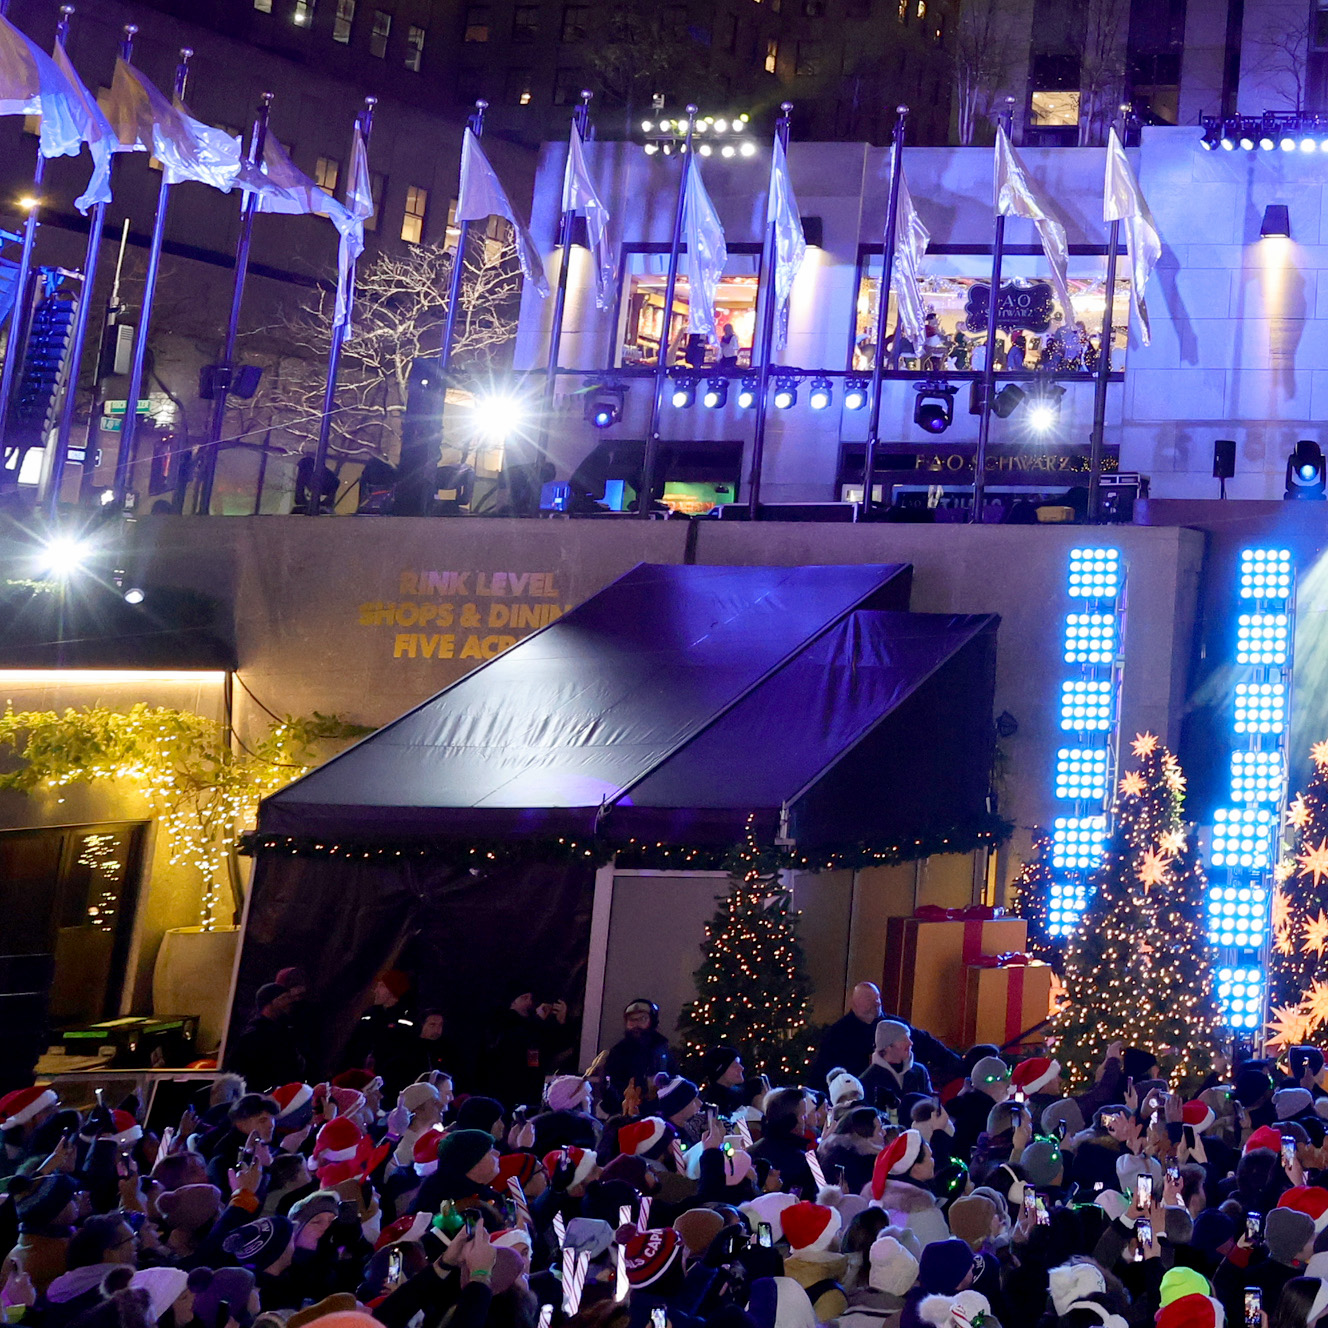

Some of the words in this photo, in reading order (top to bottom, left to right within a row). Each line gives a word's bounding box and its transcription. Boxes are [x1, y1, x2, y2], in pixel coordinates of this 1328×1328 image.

[985, 308, 1034, 317] SHWARZ
[399, 571, 470, 596] RINK
[476, 571, 559, 597] LEVEL
[358, 601, 454, 627] SHOPS
[459, 602, 481, 627] &
[488, 603, 573, 628] DININ
[393, 633, 454, 659] FIVE
[459, 633, 522, 659] ACR
